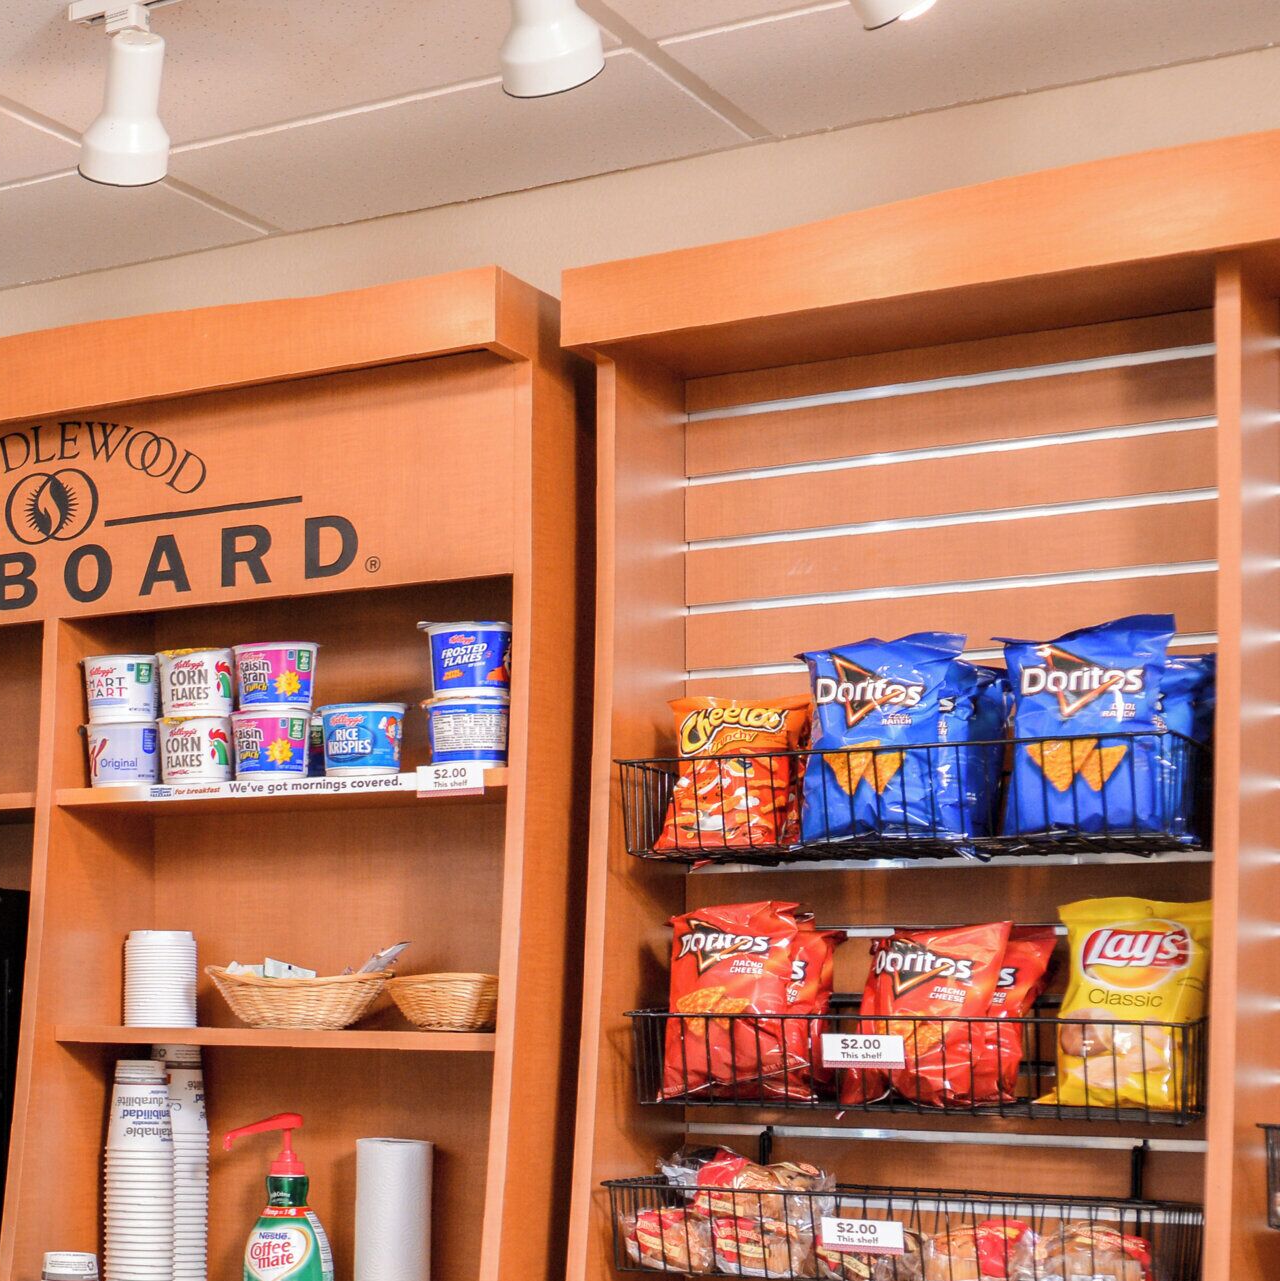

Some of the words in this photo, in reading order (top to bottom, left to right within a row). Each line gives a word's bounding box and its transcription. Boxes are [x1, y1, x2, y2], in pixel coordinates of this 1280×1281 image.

[441, 643, 488, 660] FROSTED
[174, 658, 205, 671] Kellogg's
[239, 659, 272, 674] Raisin
[443, 652, 483, 668] FLAKES
[169, 668, 209, 687] CORN
[242, 671, 268, 684] Bran
[1020, 665, 1145, 697] Doritos
[170, 686, 210, 701] FLAKES
[816, 677, 926, 705] Doritos
[328, 714, 367, 726] Kellogg's
[881, 717, 913, 726] RANCH
[1101, 709, 1136, 719] RACH
[169, 726, 198, 738] Kellogg's
[335, 727, 359, 741] RICE
[680, 707, 788, 757] Cheetos
[165, 736, 202, 754] CORN
[327, 738, 373, 755] KRISPIES
[707, 729, 759, 756] Crunchy
[100, 757, 139, 770] Original
[167, 752, 204, 769] FLAKES
[433, 767, 468, 780] $2.00
[174, 788, 186, 796] for
[186, 786, 221, 796] breakfast
[229, 782, 264, 794] We've
[268, 782, 288, 795] got
[291, 779, 348, 794] mornings
[350, 776, 404, 788] covered.
[433, 780, 451, 788] This
[452, 779, 469, 788] shelf
[678, 932, 772, 959] Doritos
[1085, 927, 1191, 968] Lay's
[729, 966, 764, 975] CHEESE
[732, 959, 764, 969] NACHO
[875, 949, 973, 980] Doritos
[928, 991, 966, 1004] CHEESE
[933, 985, 967, 997] NACHO
[1087, 987, 1164, 1009] Classic
[840, 1037, 882, 1051] $2.00
[840, 1051, 860, 1060] This
[861, 1051, 883, 1060] shelf
[836, 1221, 878, 1235] $2.00
[836, 1235, 856, 1244] This
[857, 1236, 879, 1245] shelf
[250, 1241, 292, 1260] Coffee
[258, 1252, 294, 1269] mate
